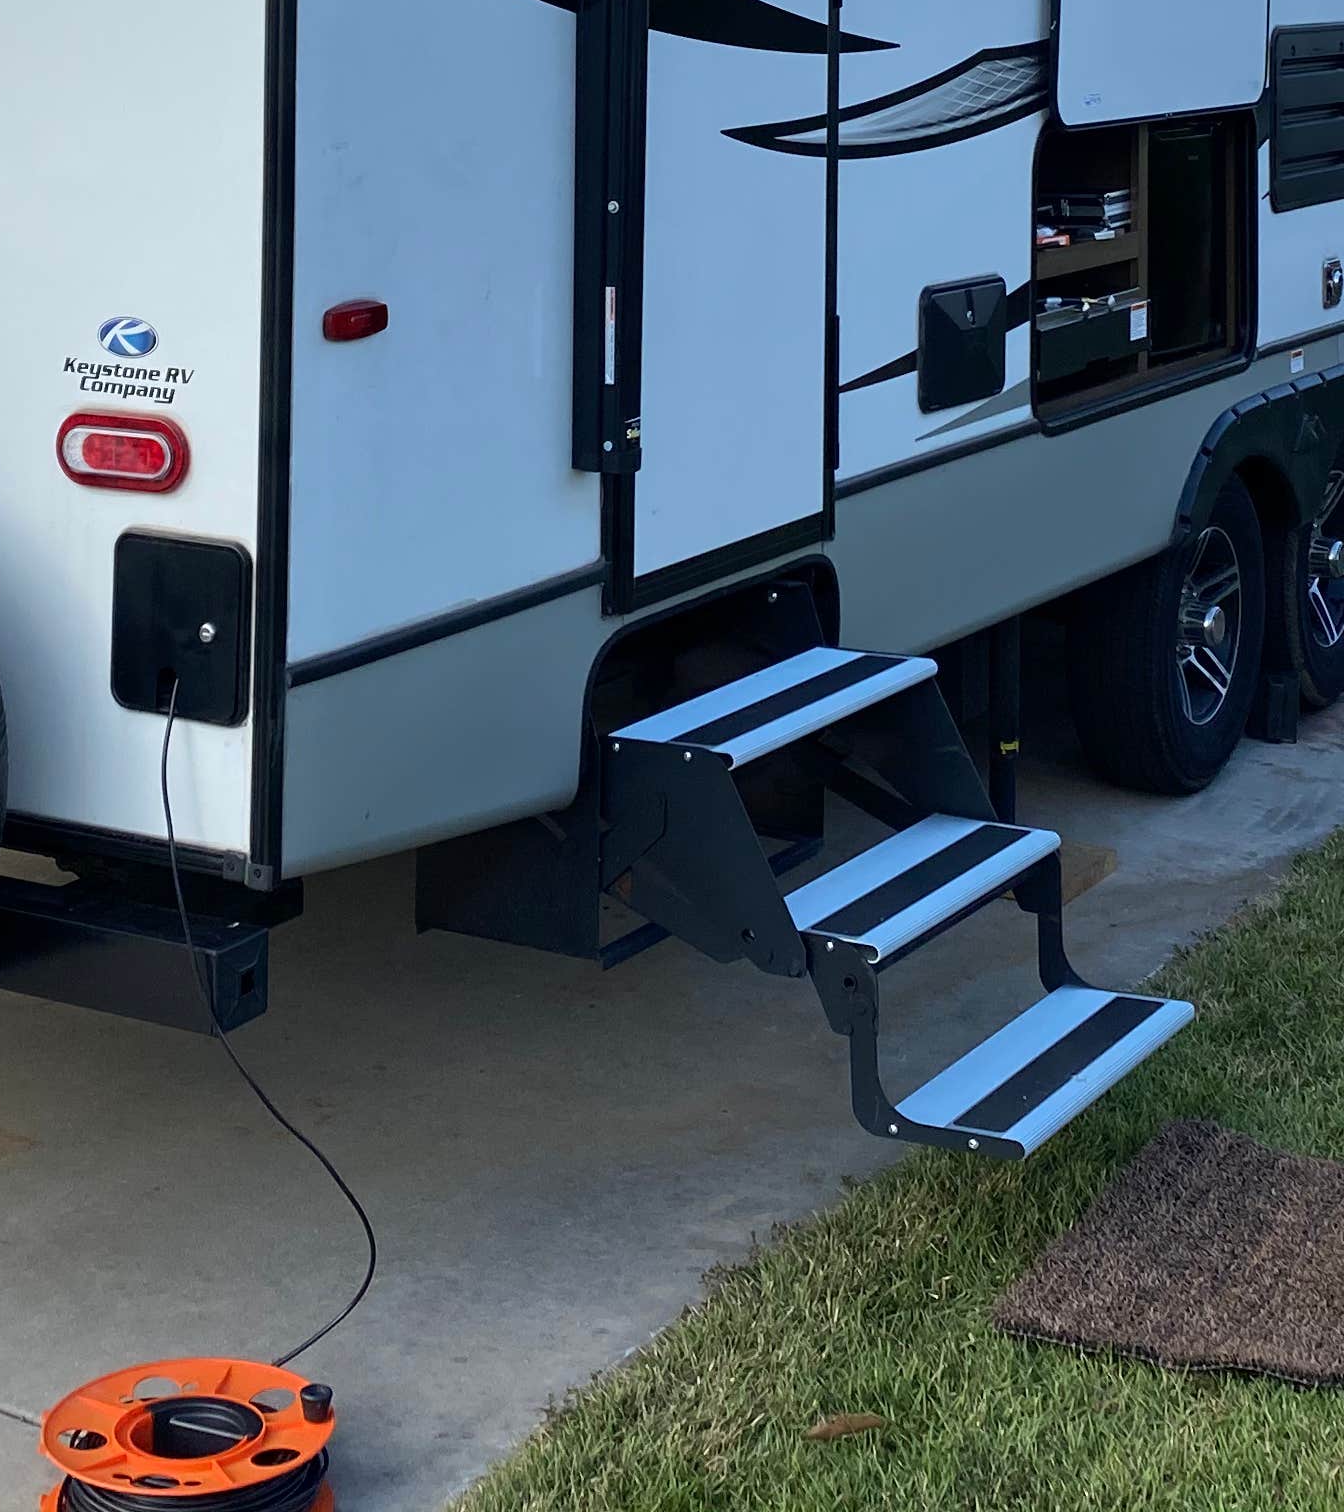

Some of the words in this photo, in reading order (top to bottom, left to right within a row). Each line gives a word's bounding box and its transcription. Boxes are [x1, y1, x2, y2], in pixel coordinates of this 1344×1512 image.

[63, 357, 161, 380] Keystone
[165, 367, 194, 384] RV
[79, 376, 175, 404] Company
